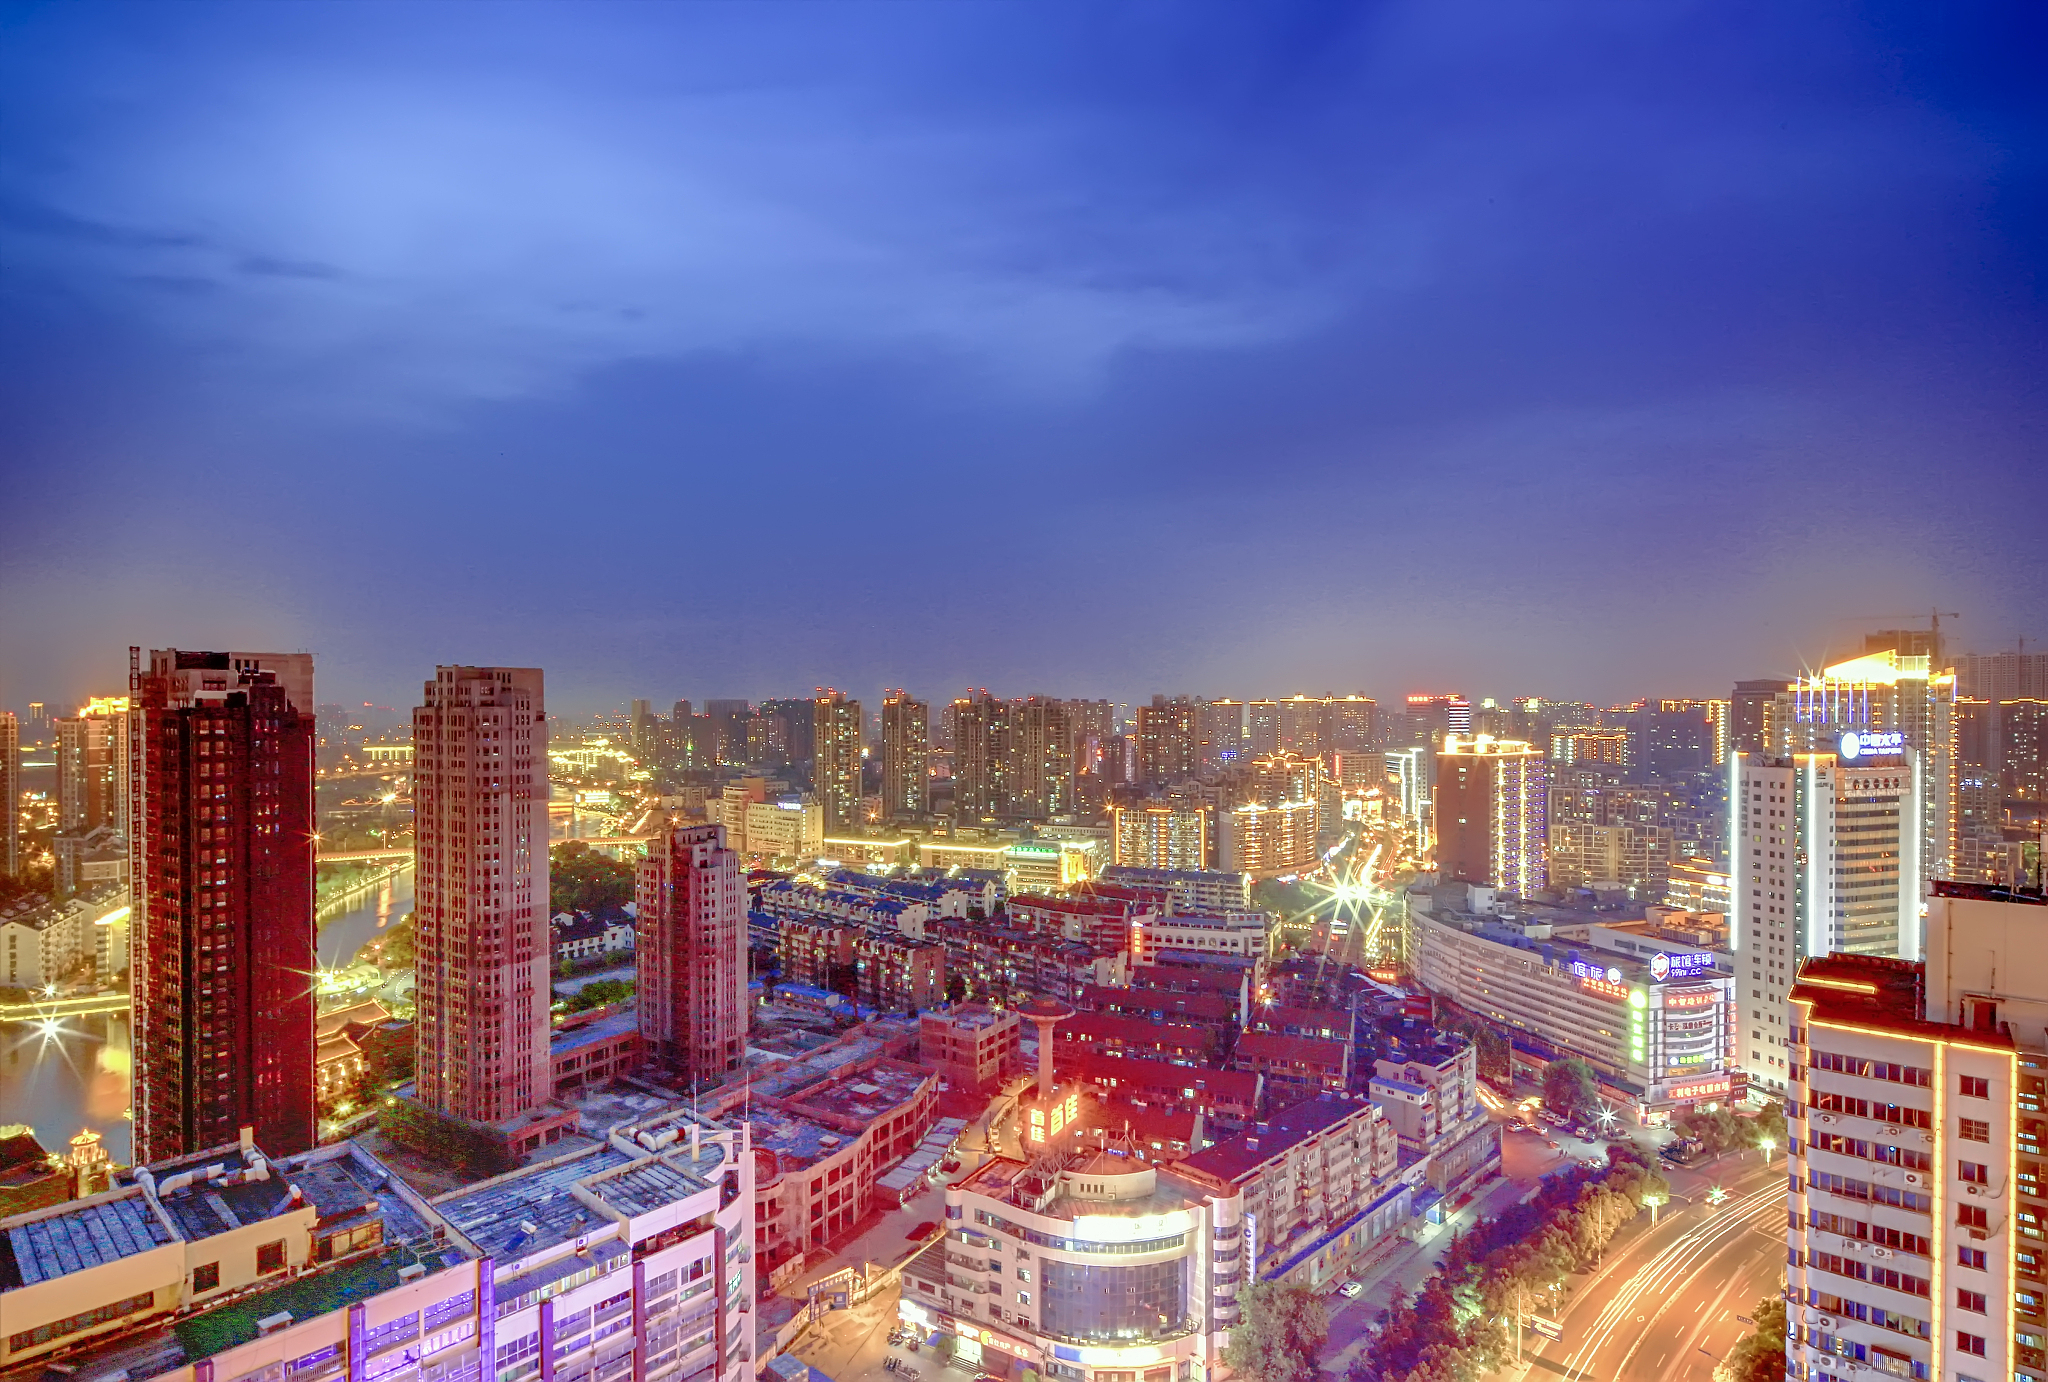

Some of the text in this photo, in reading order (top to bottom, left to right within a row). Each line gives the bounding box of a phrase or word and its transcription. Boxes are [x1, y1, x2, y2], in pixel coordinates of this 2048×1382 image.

[1668, 1081, 1730, 1099] 汇利电子电器市场
[1030, 1108, 1045, 1142] 首佳
[1050, 1094, 1077, 1136] 首佳
